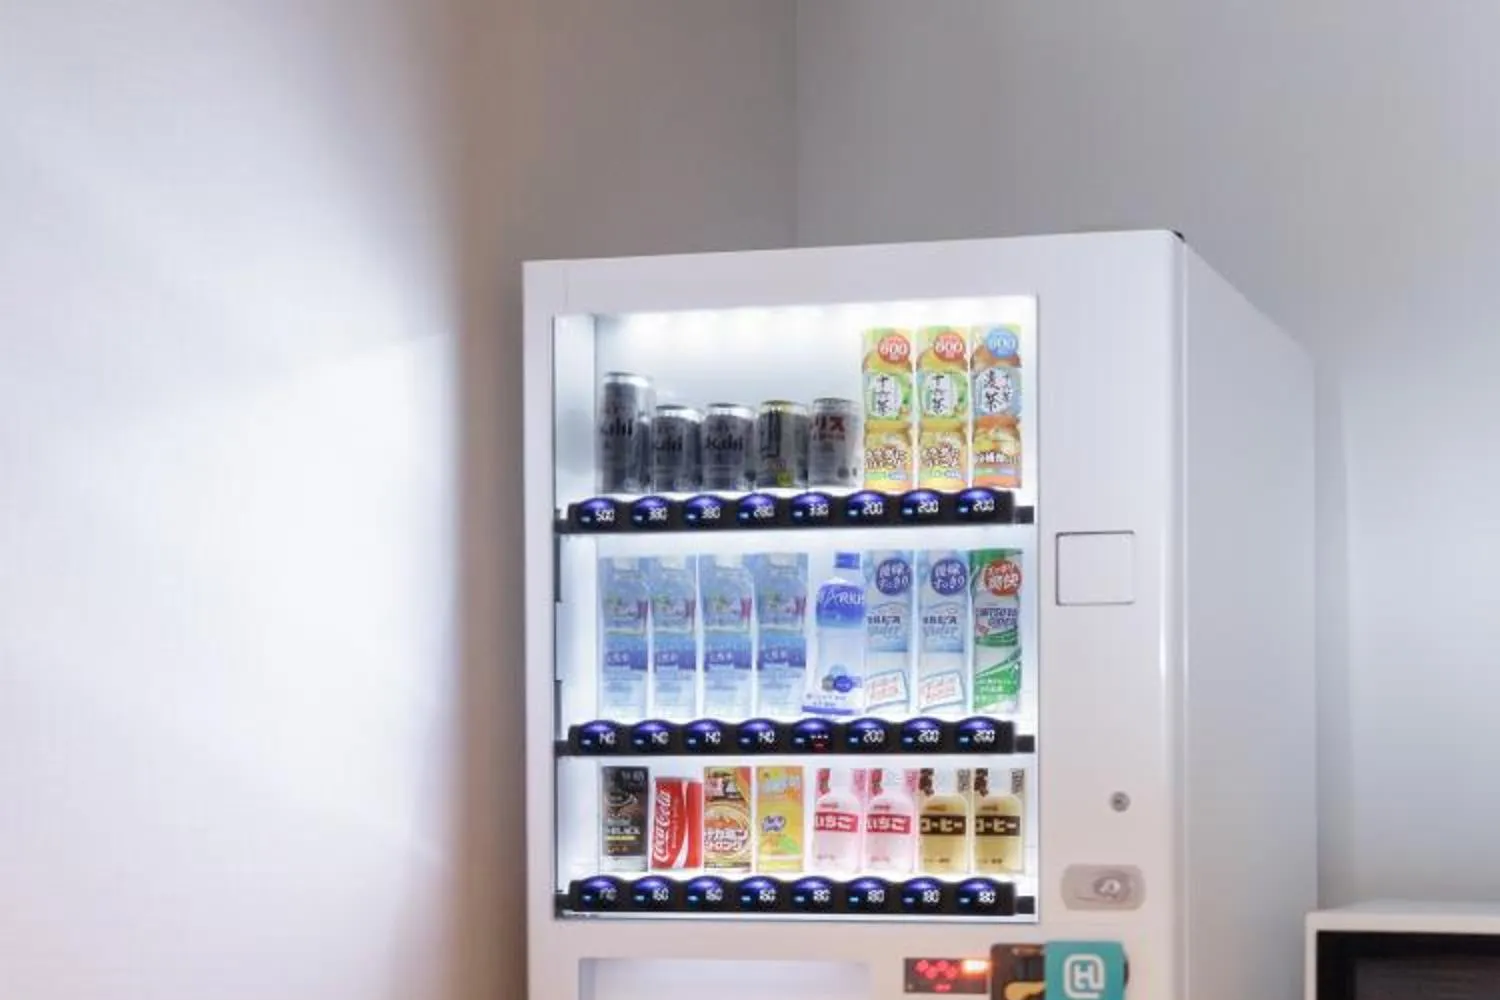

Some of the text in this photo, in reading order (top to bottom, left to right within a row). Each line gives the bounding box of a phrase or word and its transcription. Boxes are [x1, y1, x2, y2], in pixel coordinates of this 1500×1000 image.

[863, 503, 883, 515] 200
[918, 501, 939, 514] 200
[973, 499, 994, 512] 200
[863, 729, 885, 743] 200
[918, 729, 940, 743] 200
[973, 729, 995, 743] 200
